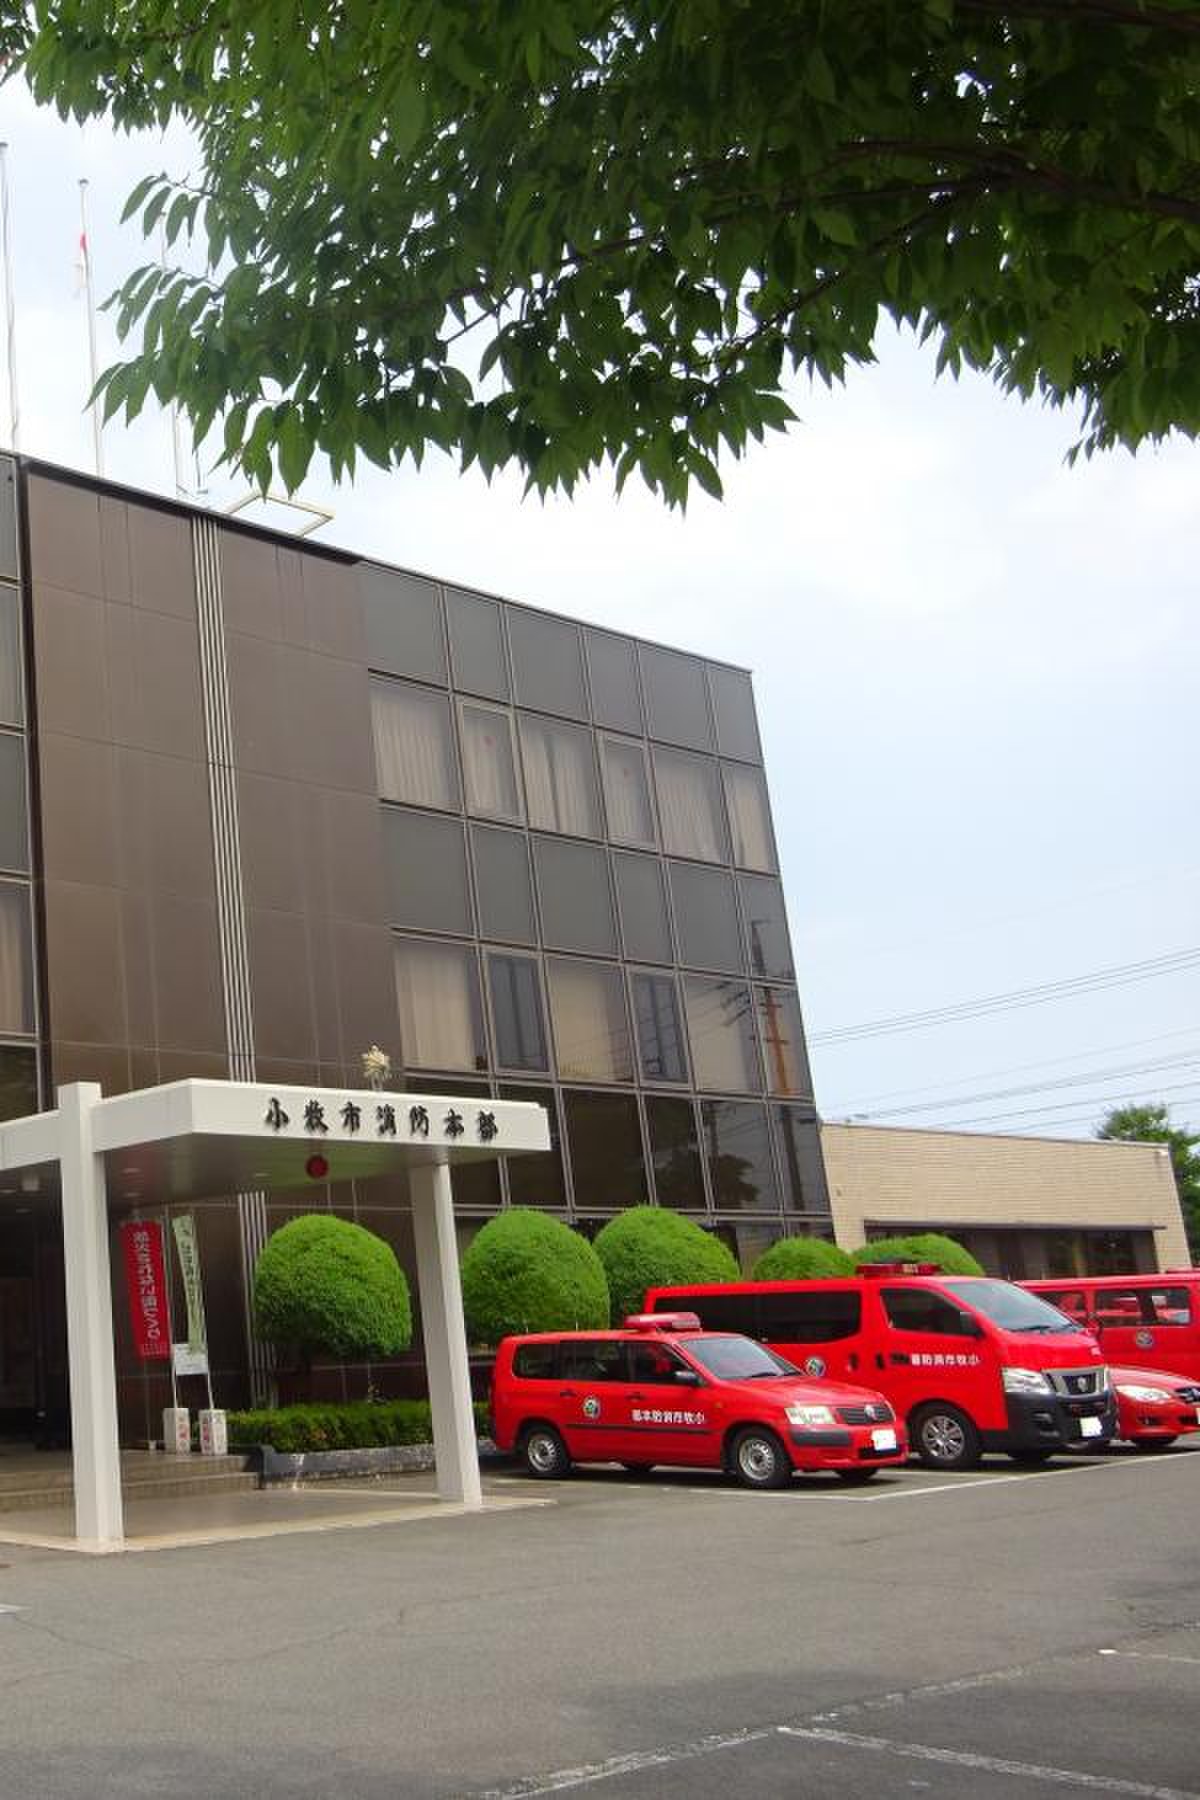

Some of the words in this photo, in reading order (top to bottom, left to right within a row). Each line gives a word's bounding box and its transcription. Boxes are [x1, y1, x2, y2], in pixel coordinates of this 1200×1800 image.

[265, 1097, 498, 1141] 小牧市消防本部
